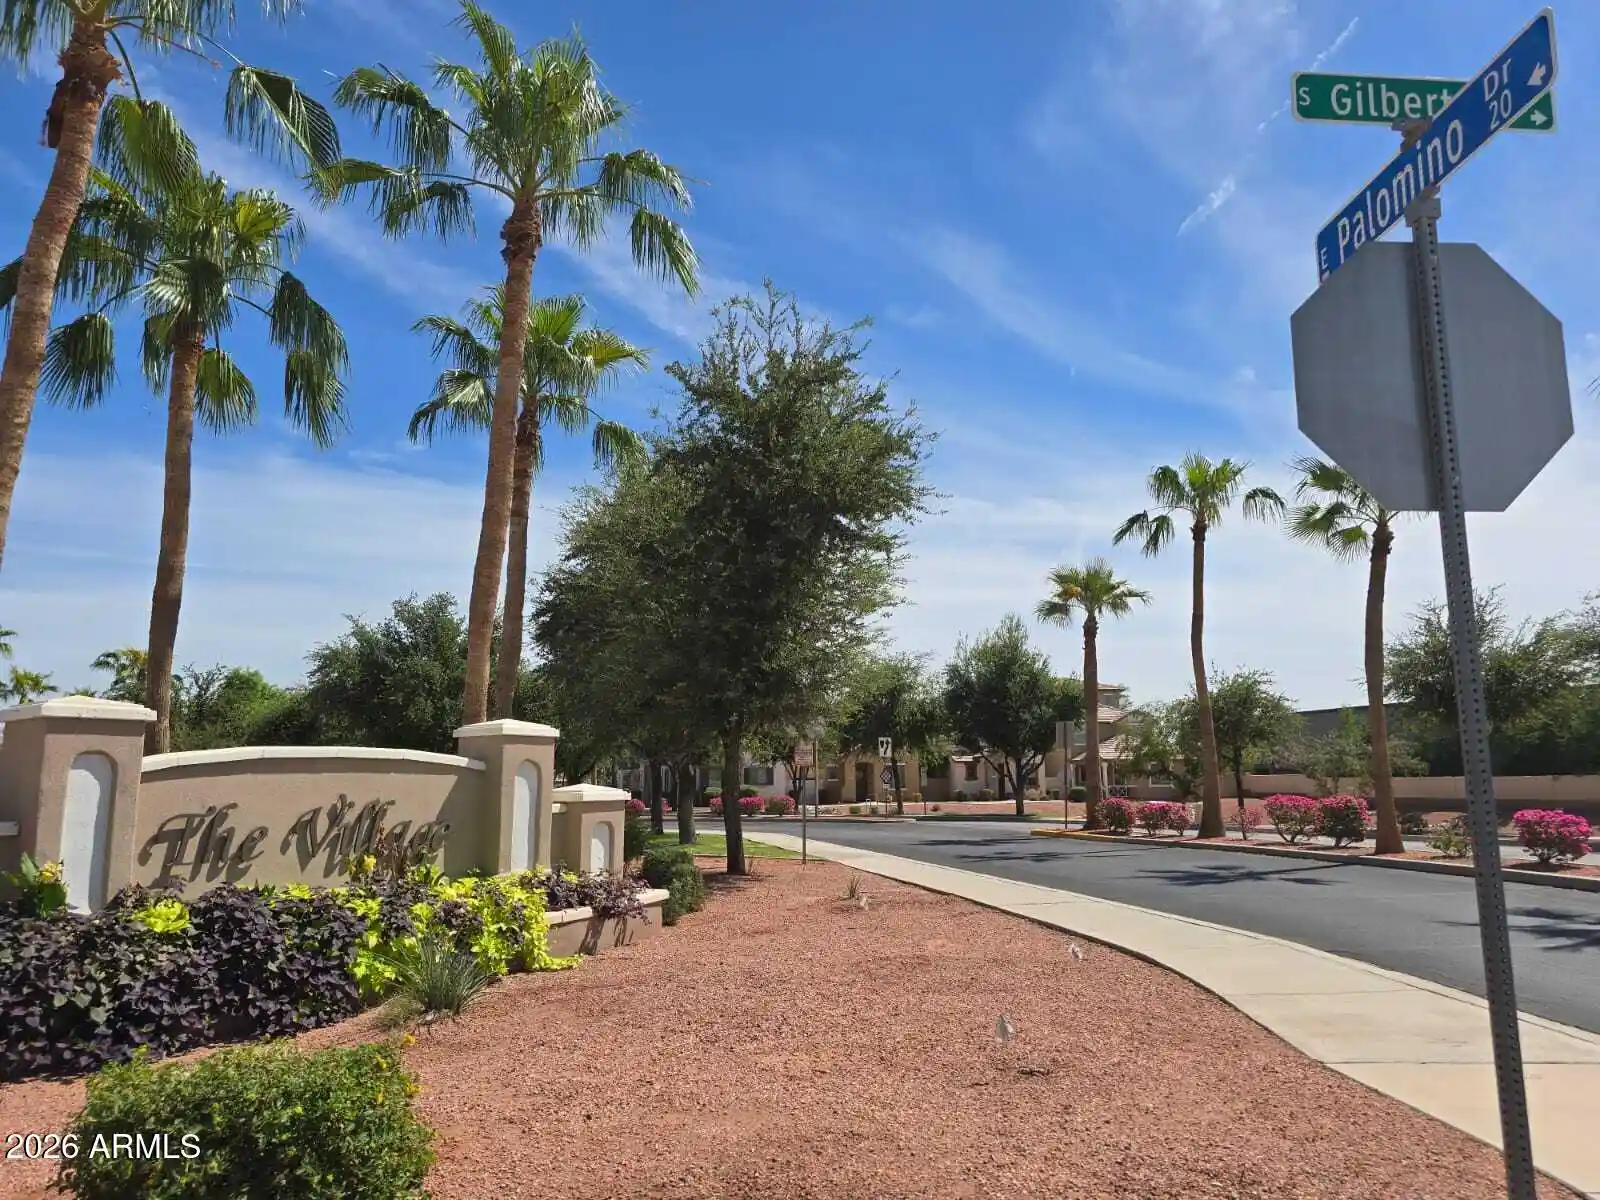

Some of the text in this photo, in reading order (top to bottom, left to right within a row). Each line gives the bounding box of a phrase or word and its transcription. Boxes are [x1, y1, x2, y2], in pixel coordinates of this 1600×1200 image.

[1299, 83, 1452, 119] S Gilbert
[1488, 89, 1512, 131] 20
[1320, 58, 1512, 270] E Palomino Dr
[138, 802, 269, 867] The
